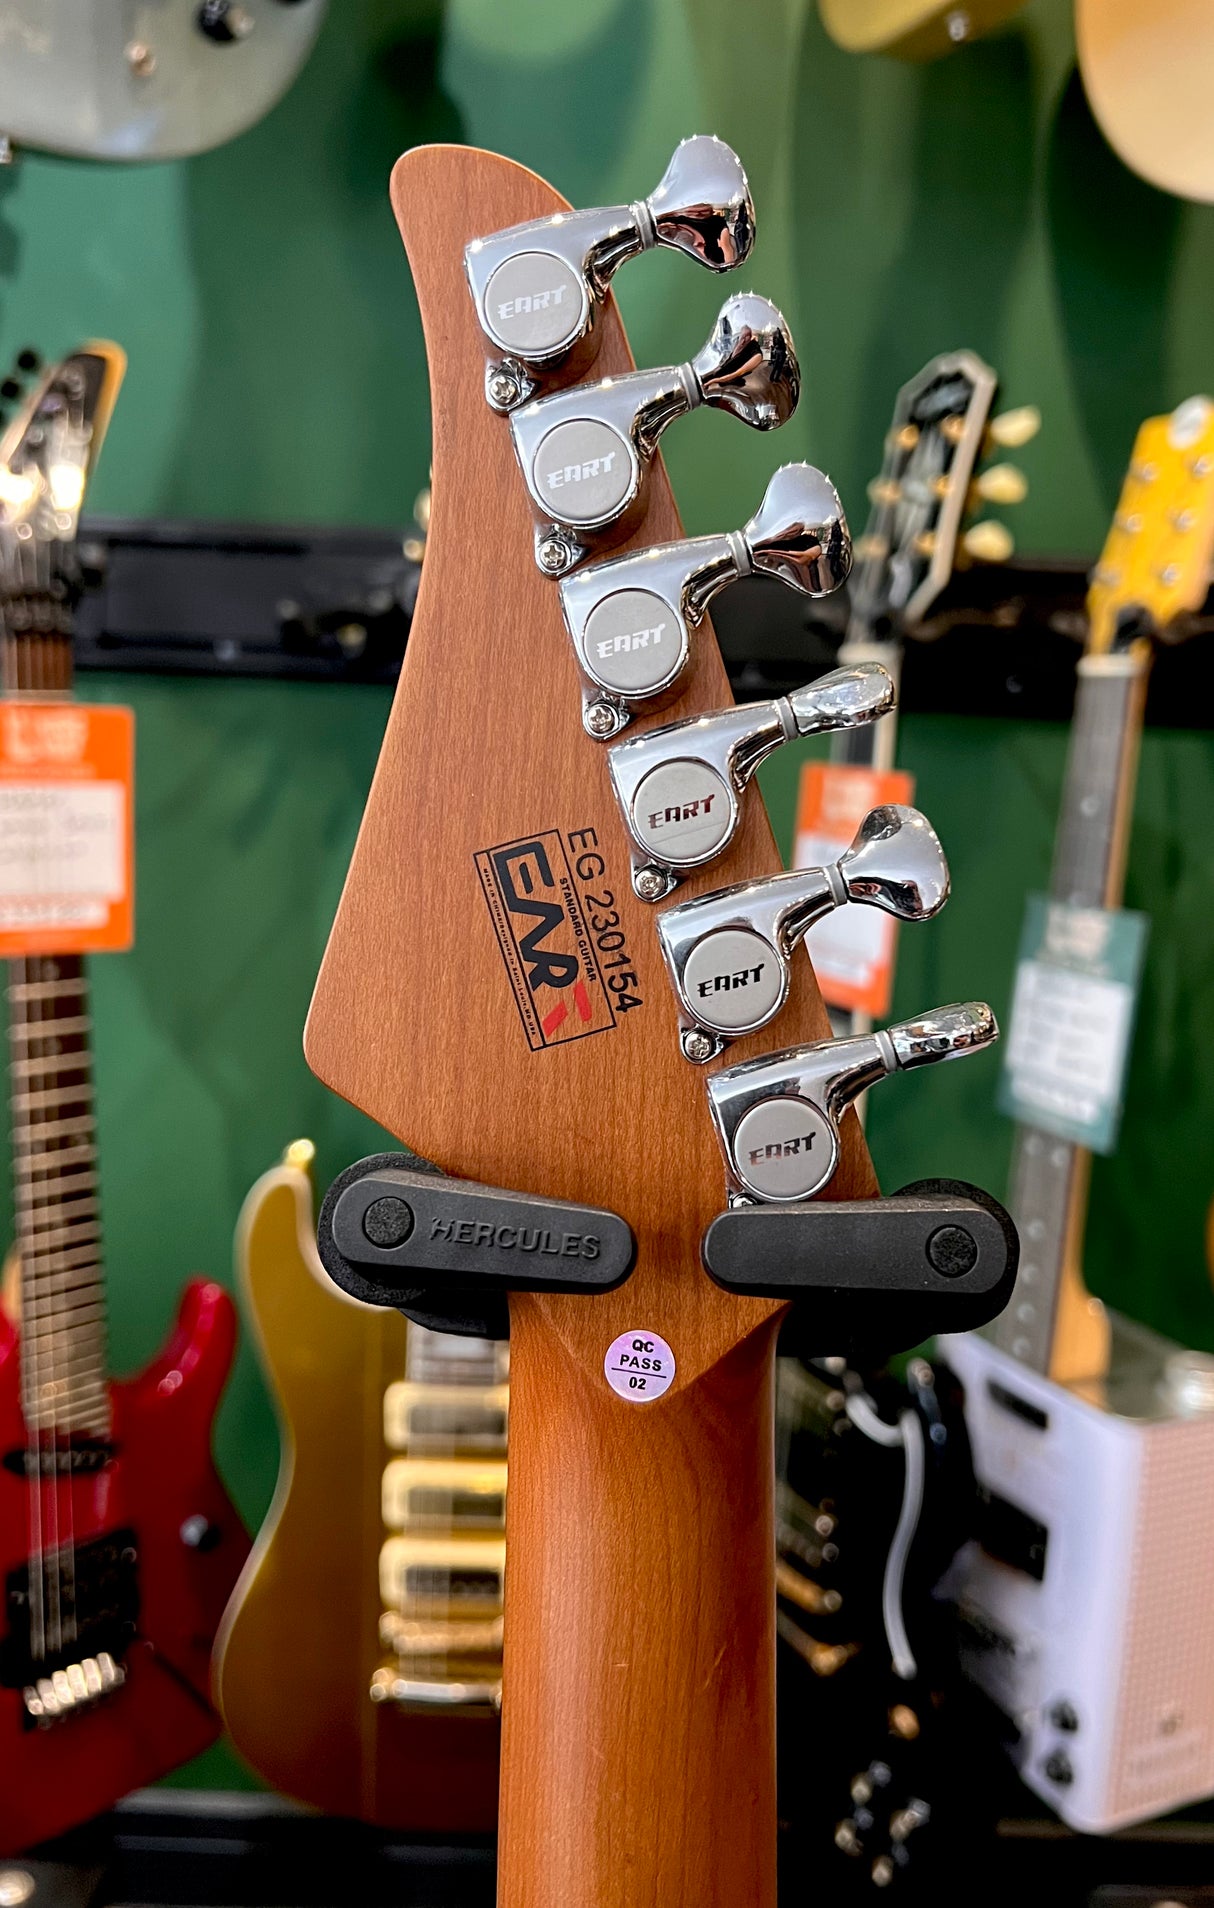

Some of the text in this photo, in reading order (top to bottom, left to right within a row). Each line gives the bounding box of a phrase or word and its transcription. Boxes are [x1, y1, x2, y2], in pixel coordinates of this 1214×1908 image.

[497, 285, 567, 320] EART
[547, 451, 616, 489] EART
[597, 623, 666, 659] EART
[648, 794, 715, 829] EART
[559, 877, 596, 982] STANDARD GUITAR
[567, 827, 643, 1013] EG 230154
[697, 963, 765, 998] EART
[748, 1131, 817, 1166] EART
[430, 1217, 601, 1260] HERCULES
[620, 1354, 662, 1371] PASS
[632, 1339, 654, 1353] QC
[629, 1376, 647, 1390] 02
